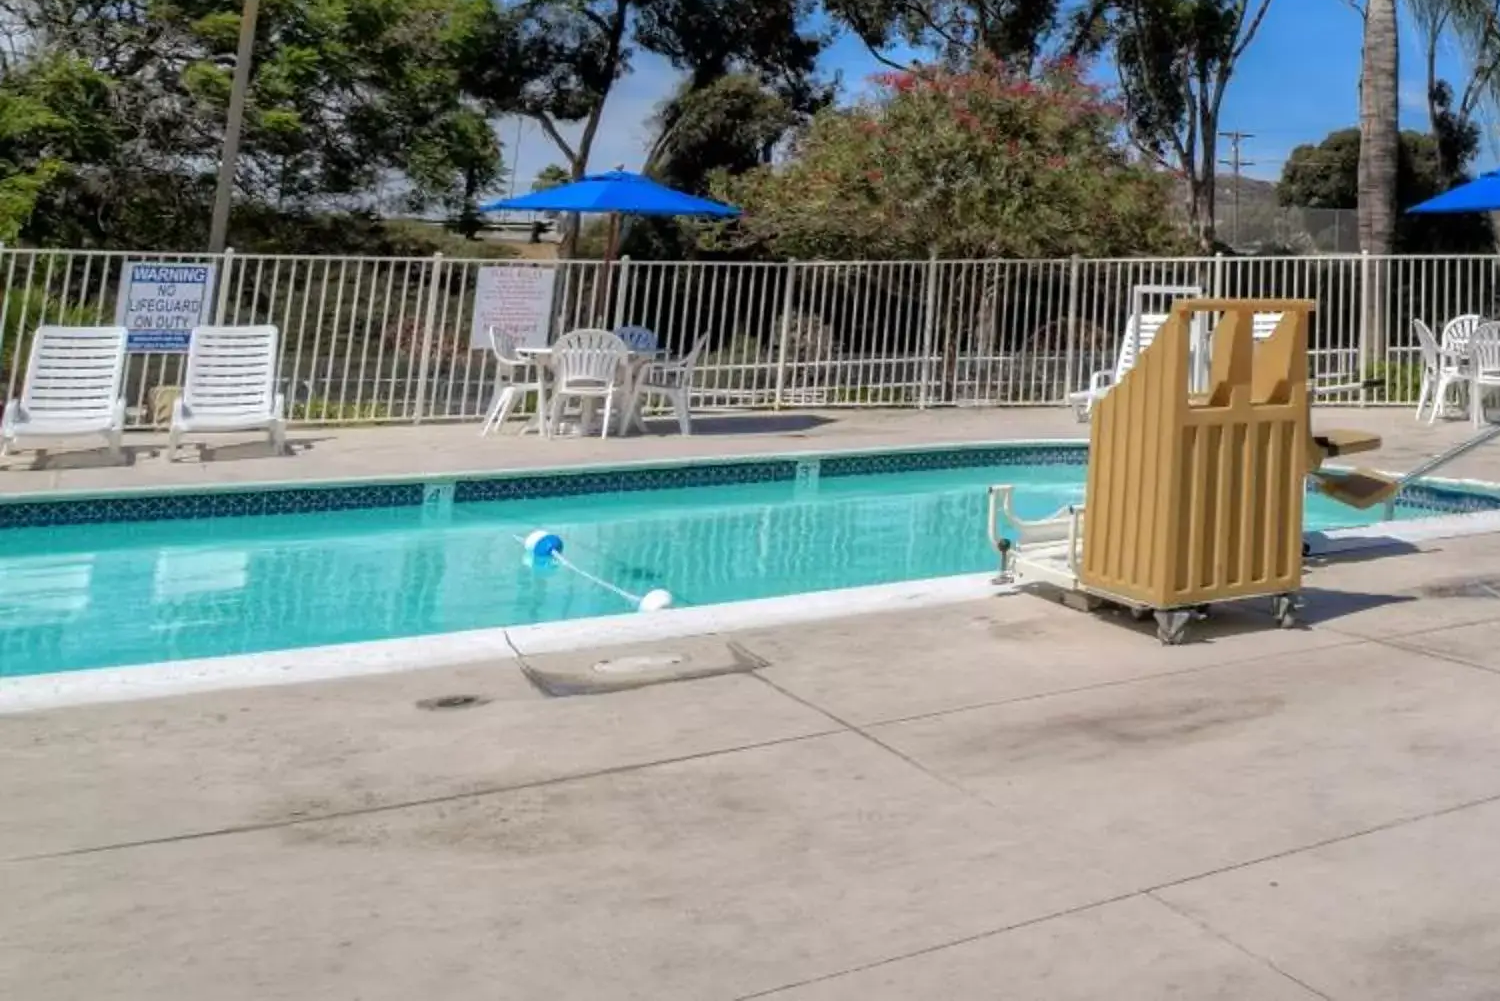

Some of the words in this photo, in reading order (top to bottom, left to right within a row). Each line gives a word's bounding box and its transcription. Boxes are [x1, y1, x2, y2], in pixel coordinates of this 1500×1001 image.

[134, 268, 205, 281] WARNING
[158, 284, 176, 296] NO
[130, 299, 199, 311] LIFEGUARD
[134, 315, 152, 327] ON
[156, 315, 188, 327] DUTY
